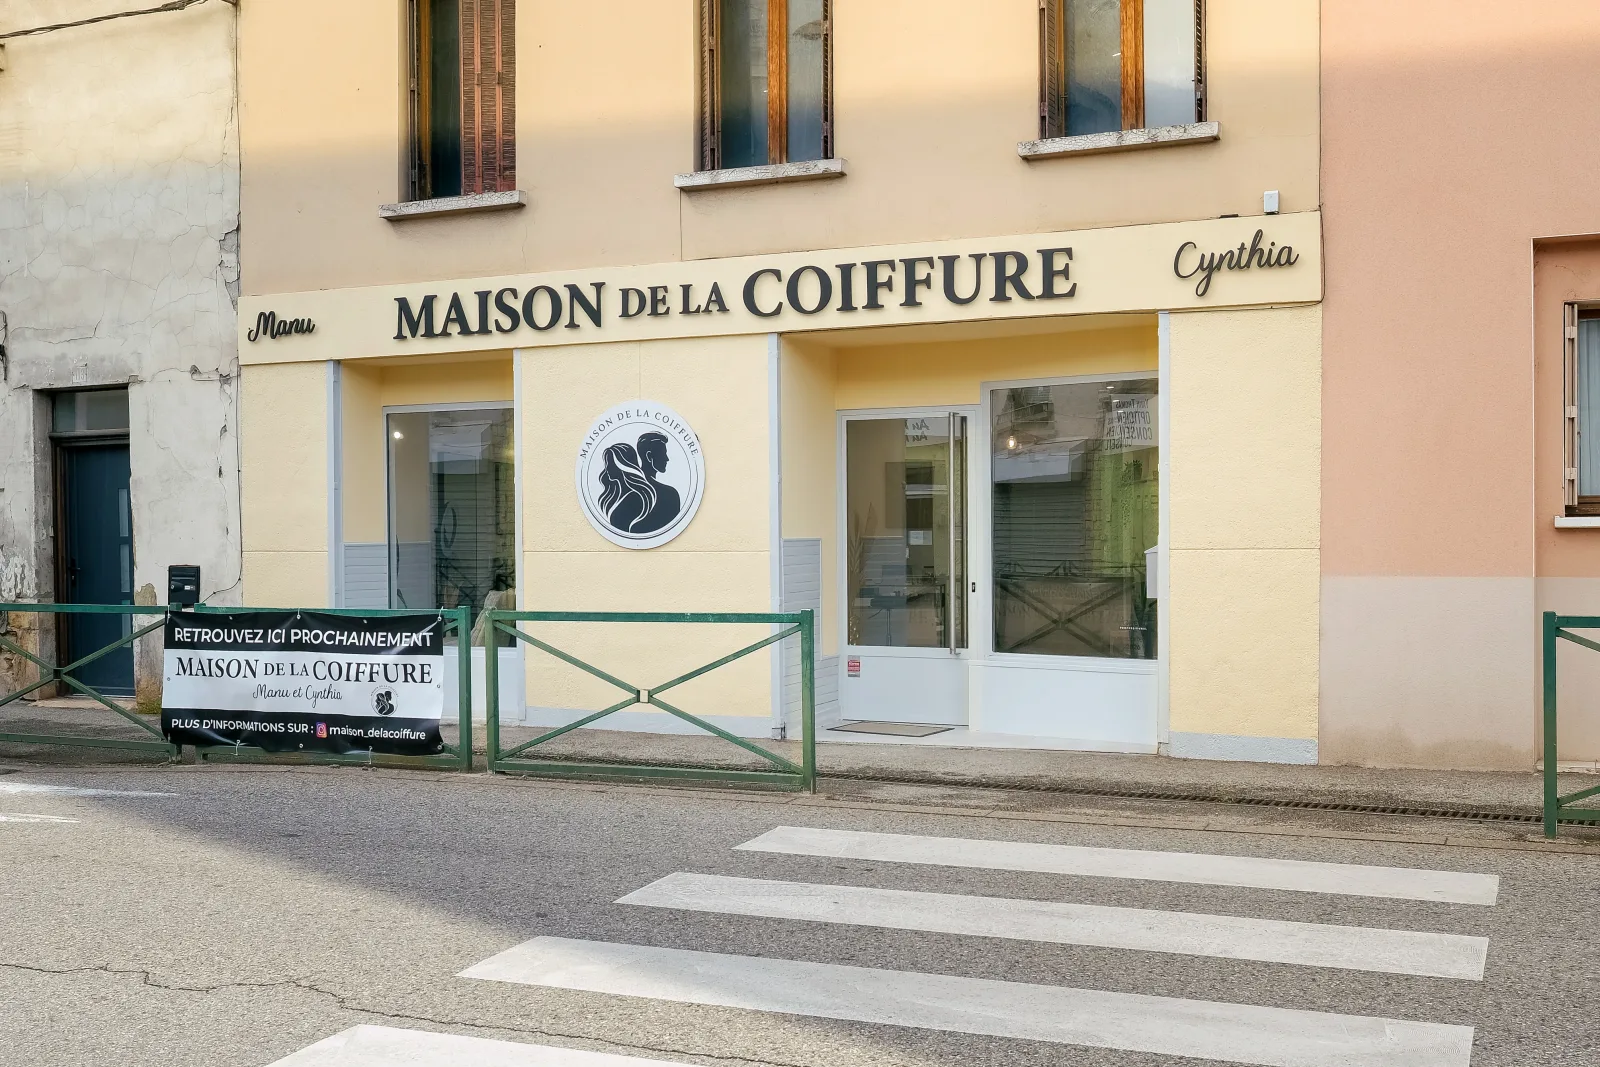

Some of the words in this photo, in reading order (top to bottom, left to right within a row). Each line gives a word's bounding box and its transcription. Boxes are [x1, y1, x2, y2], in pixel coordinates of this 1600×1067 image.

[1173, 229, 1300, 298] Cynthia
[393, 281, 606, 340] MAISON
[618, 285, 670, 318] DE
[679, 281, 730, 314] LA
[742, 246, 1078, 317] COIFFURE
[247, 310, 316, 342] Manu
[580, 418, 614, 459] MAISON
[617, 410, 632, 421] DE
[636, 409, 650, 418] LA
[654, 412, 699, 456] COIFFURE
[174, 628, 263, 643] RETROUVEZ
[267, 629, 285, 644] ICI
[290, 629, 433, 647] PROCHAINEMENT
[175, 657, 260, 679] MAISON
[264, 663, 286, 676] DE
[289, 663, 309, 677] LA
[313, 660, 433, 684] COIFFURE
[253, 684, 290, 699] Manu
[292, 686, 303, 698] et
[305, 684, 342, 708] Cynthia
[171, 719, 200, 729] PLUS
[202, 720, 285, 732] D'INFORMATIONS
[287, 723, 309, 733] SUR
[329, 725, 426, 740] maison_delacoiffure
